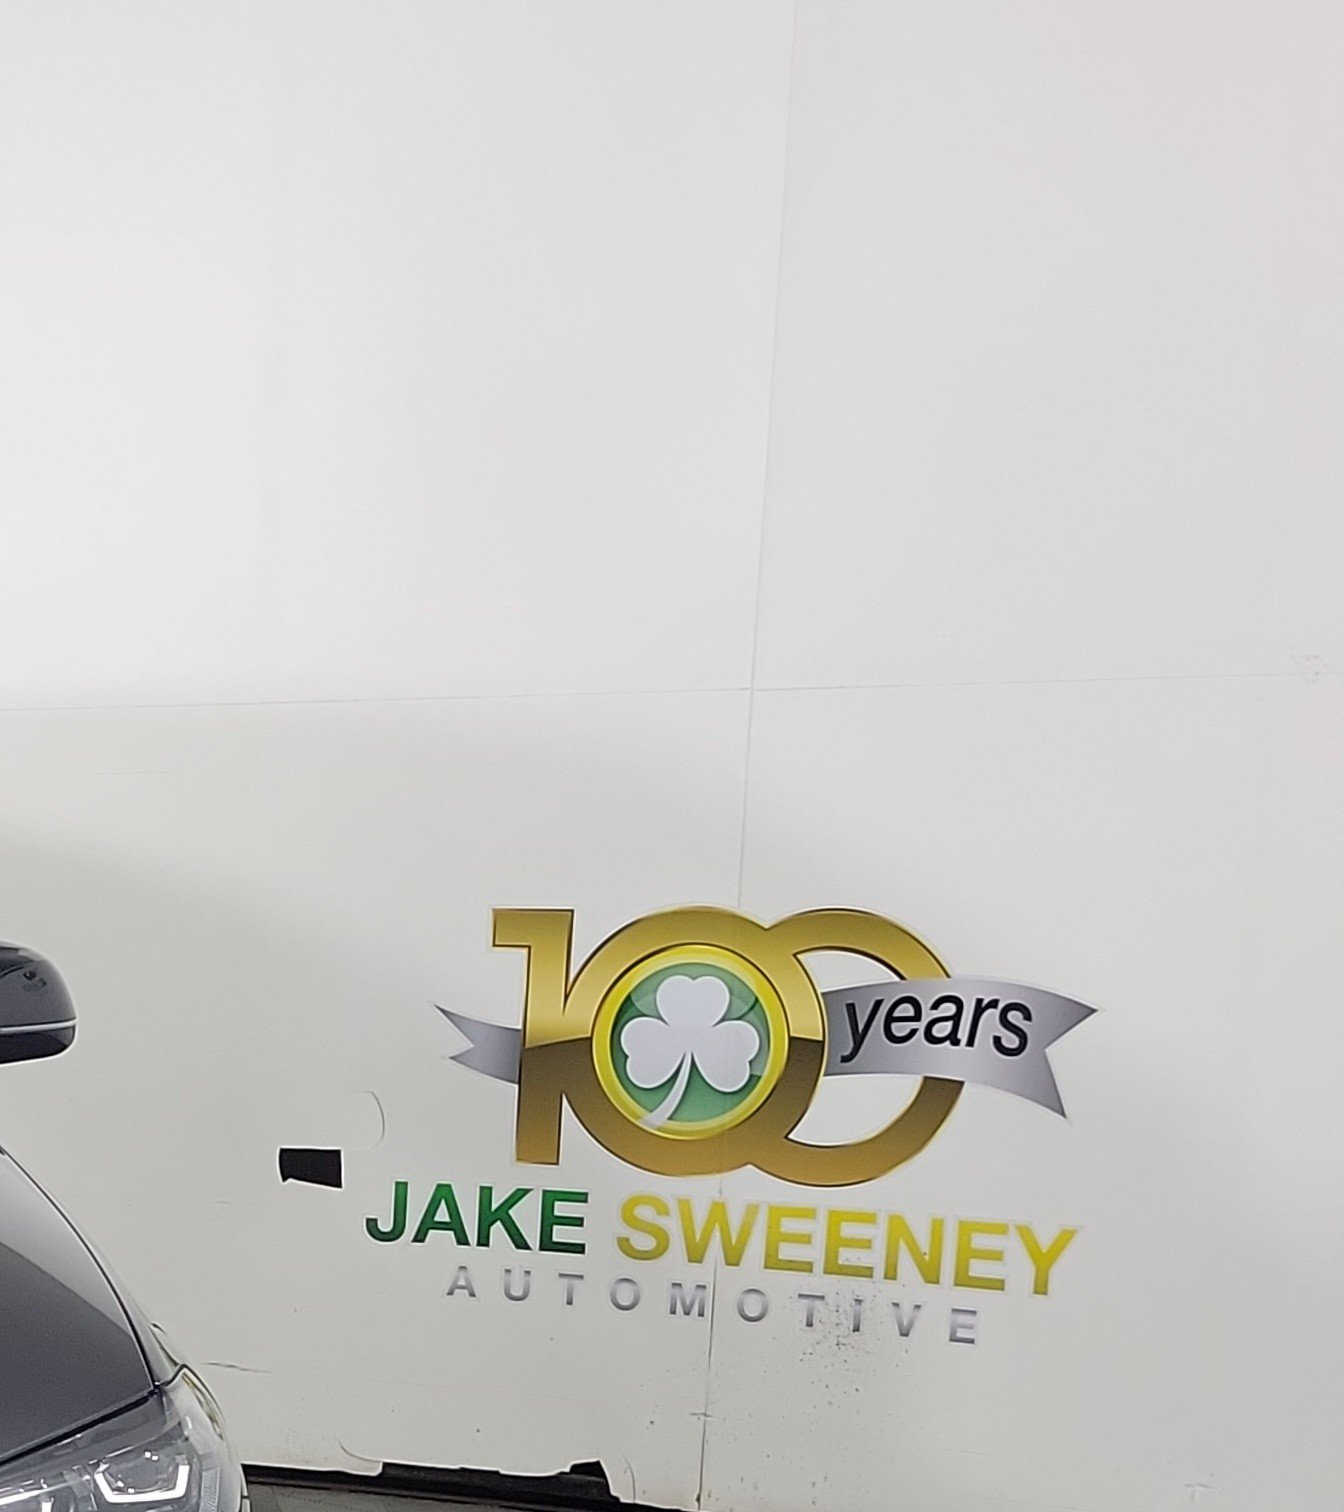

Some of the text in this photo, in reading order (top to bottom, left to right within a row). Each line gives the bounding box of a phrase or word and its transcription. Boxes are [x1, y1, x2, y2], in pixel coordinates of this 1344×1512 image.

[491, 906, 1032, 1187] 100 years
[365, 1181, 1078, 1296] JAKE SWEENEY
[445, 1264, 978, 1345] AUTOMOTIVE
